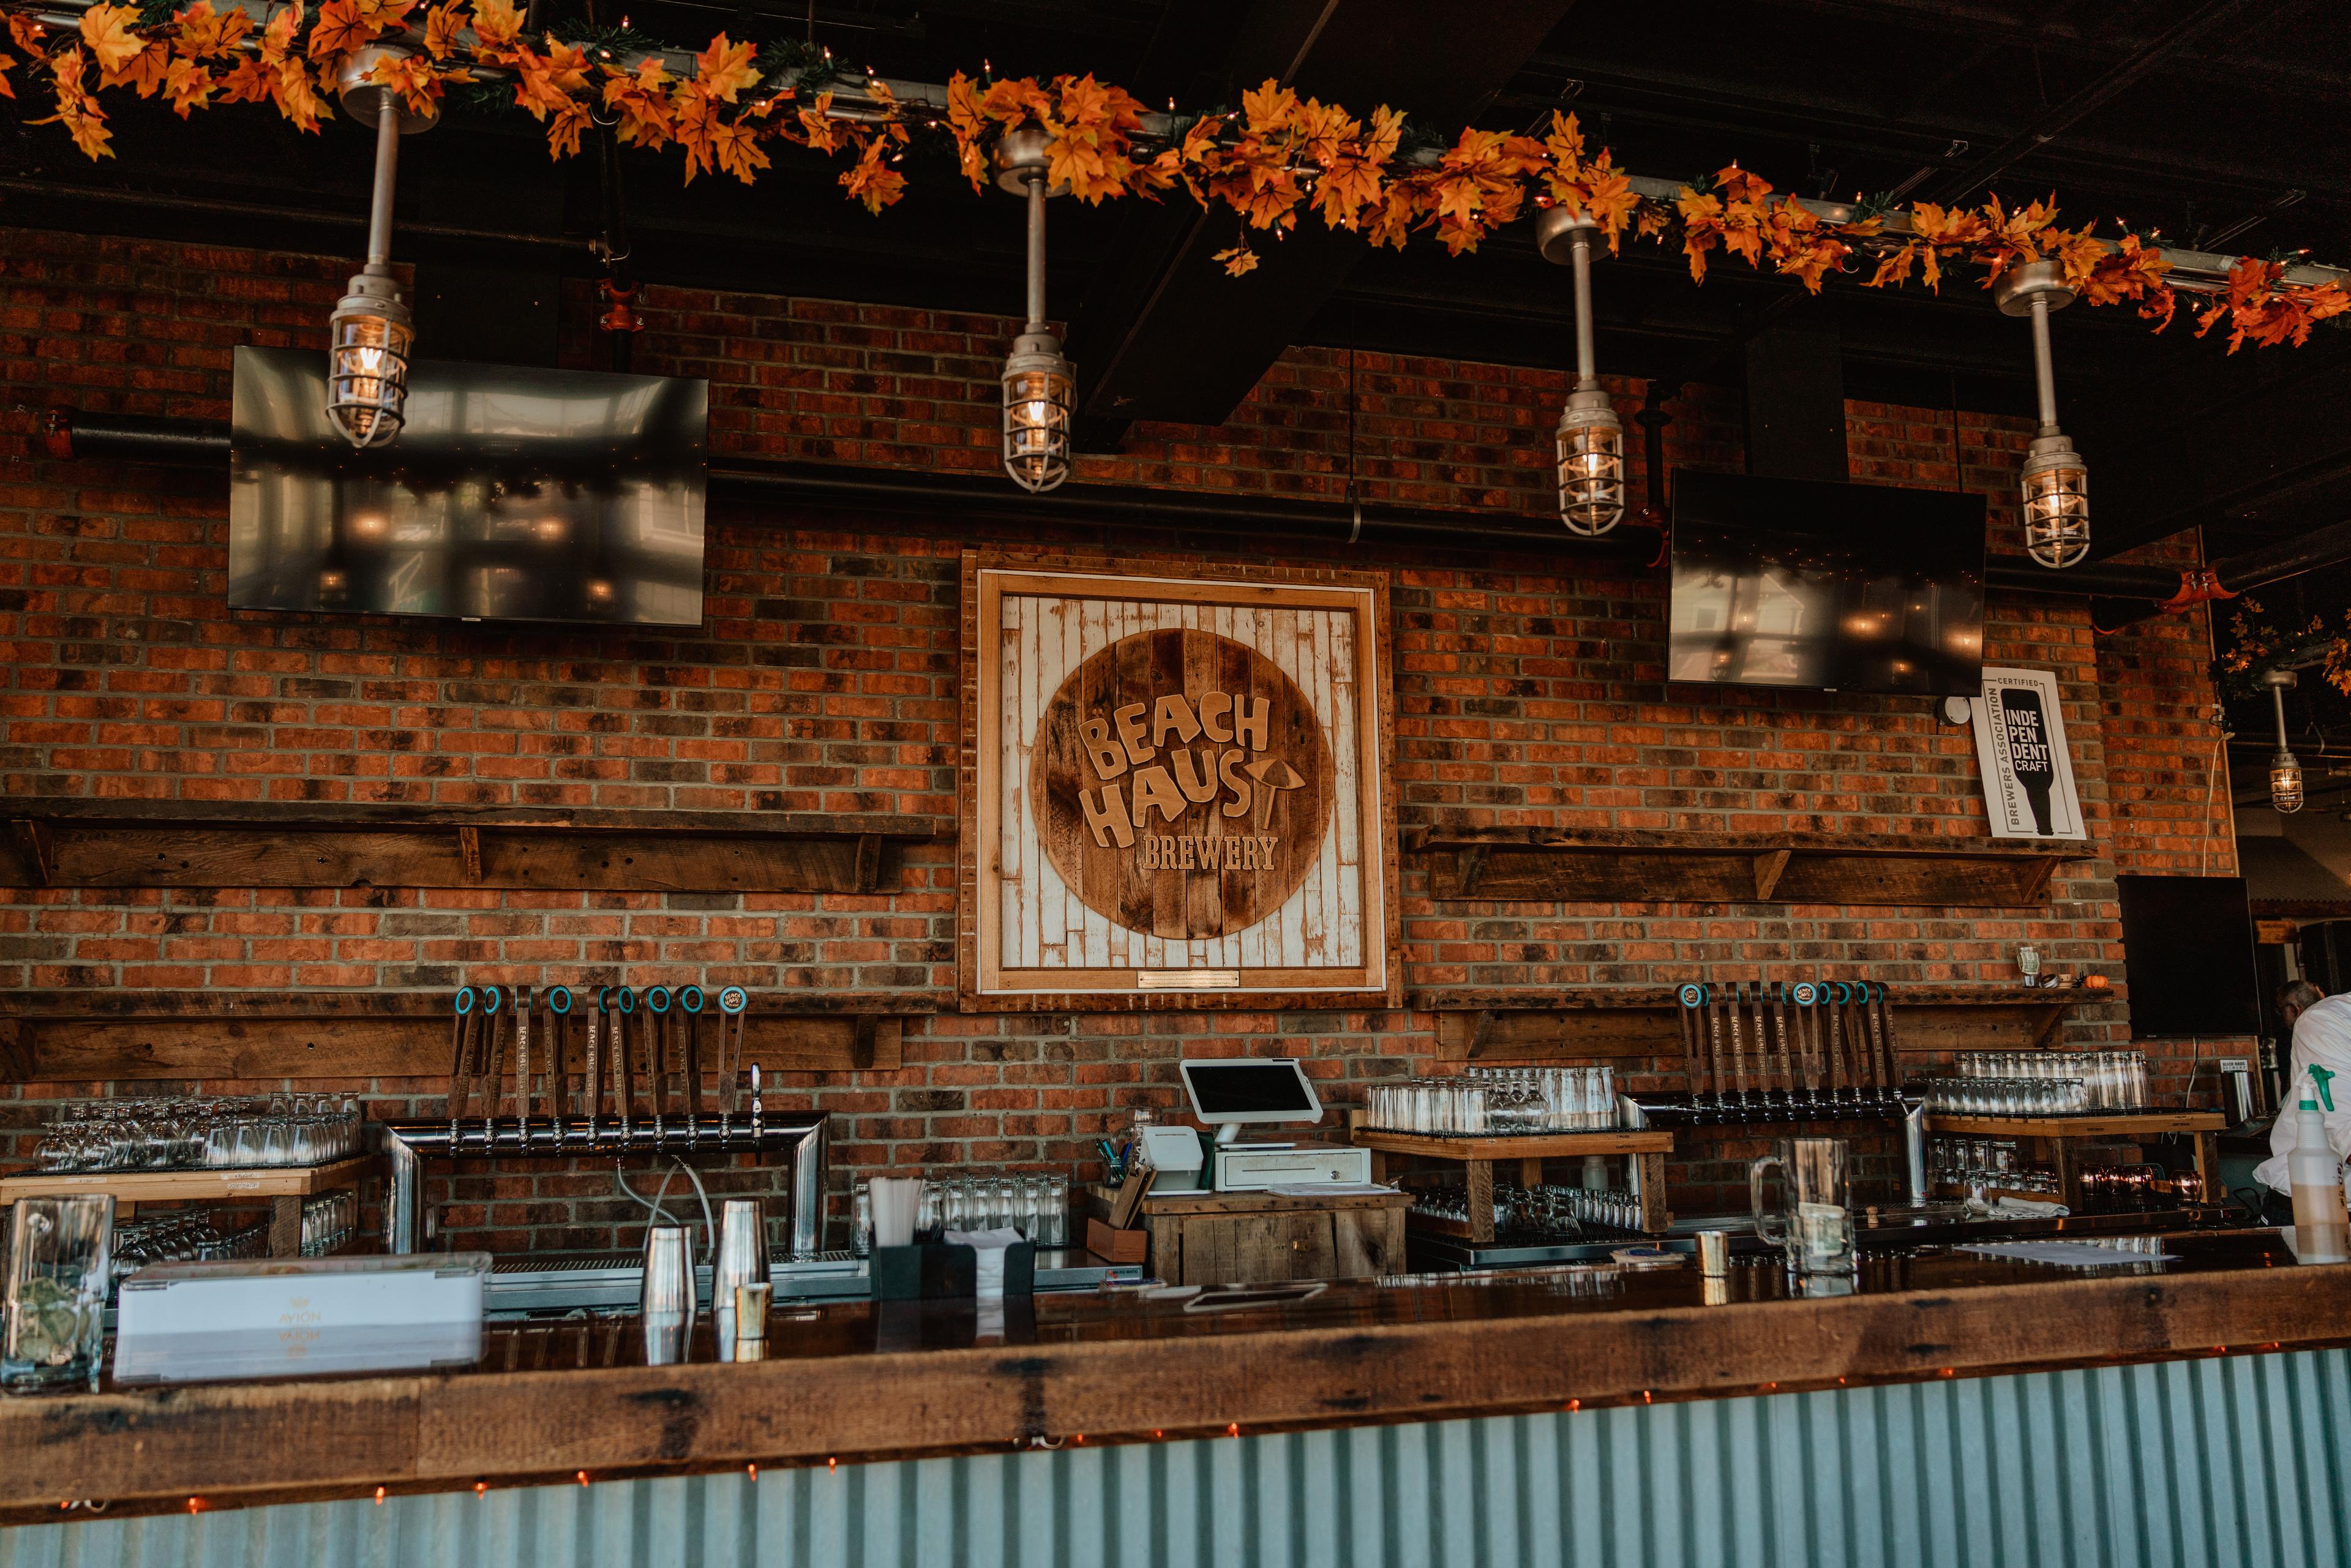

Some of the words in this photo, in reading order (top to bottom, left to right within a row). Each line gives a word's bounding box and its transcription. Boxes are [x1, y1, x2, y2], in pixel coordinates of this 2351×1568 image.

[1998, 677, 2039, 687] CERTIFIED
[1988, 687, 2010, 764] ASSOCIATION
[2005, 709, 2039, 727] INDE
[1078, 691, 1270, 781] BEACH
[2008, 726, 2038, 743] PEN
[2011, 743, 2048, 760] DENT
[2014, 760, 2048, 772] CRAFT
[1078, 748, 1251, 849] HAUS
[2001, 767, 2020, 826] BREWERS
[1142, 835, 1279, 871] BREWERY
[1778, 1037, 1787, 1054] HAUS
